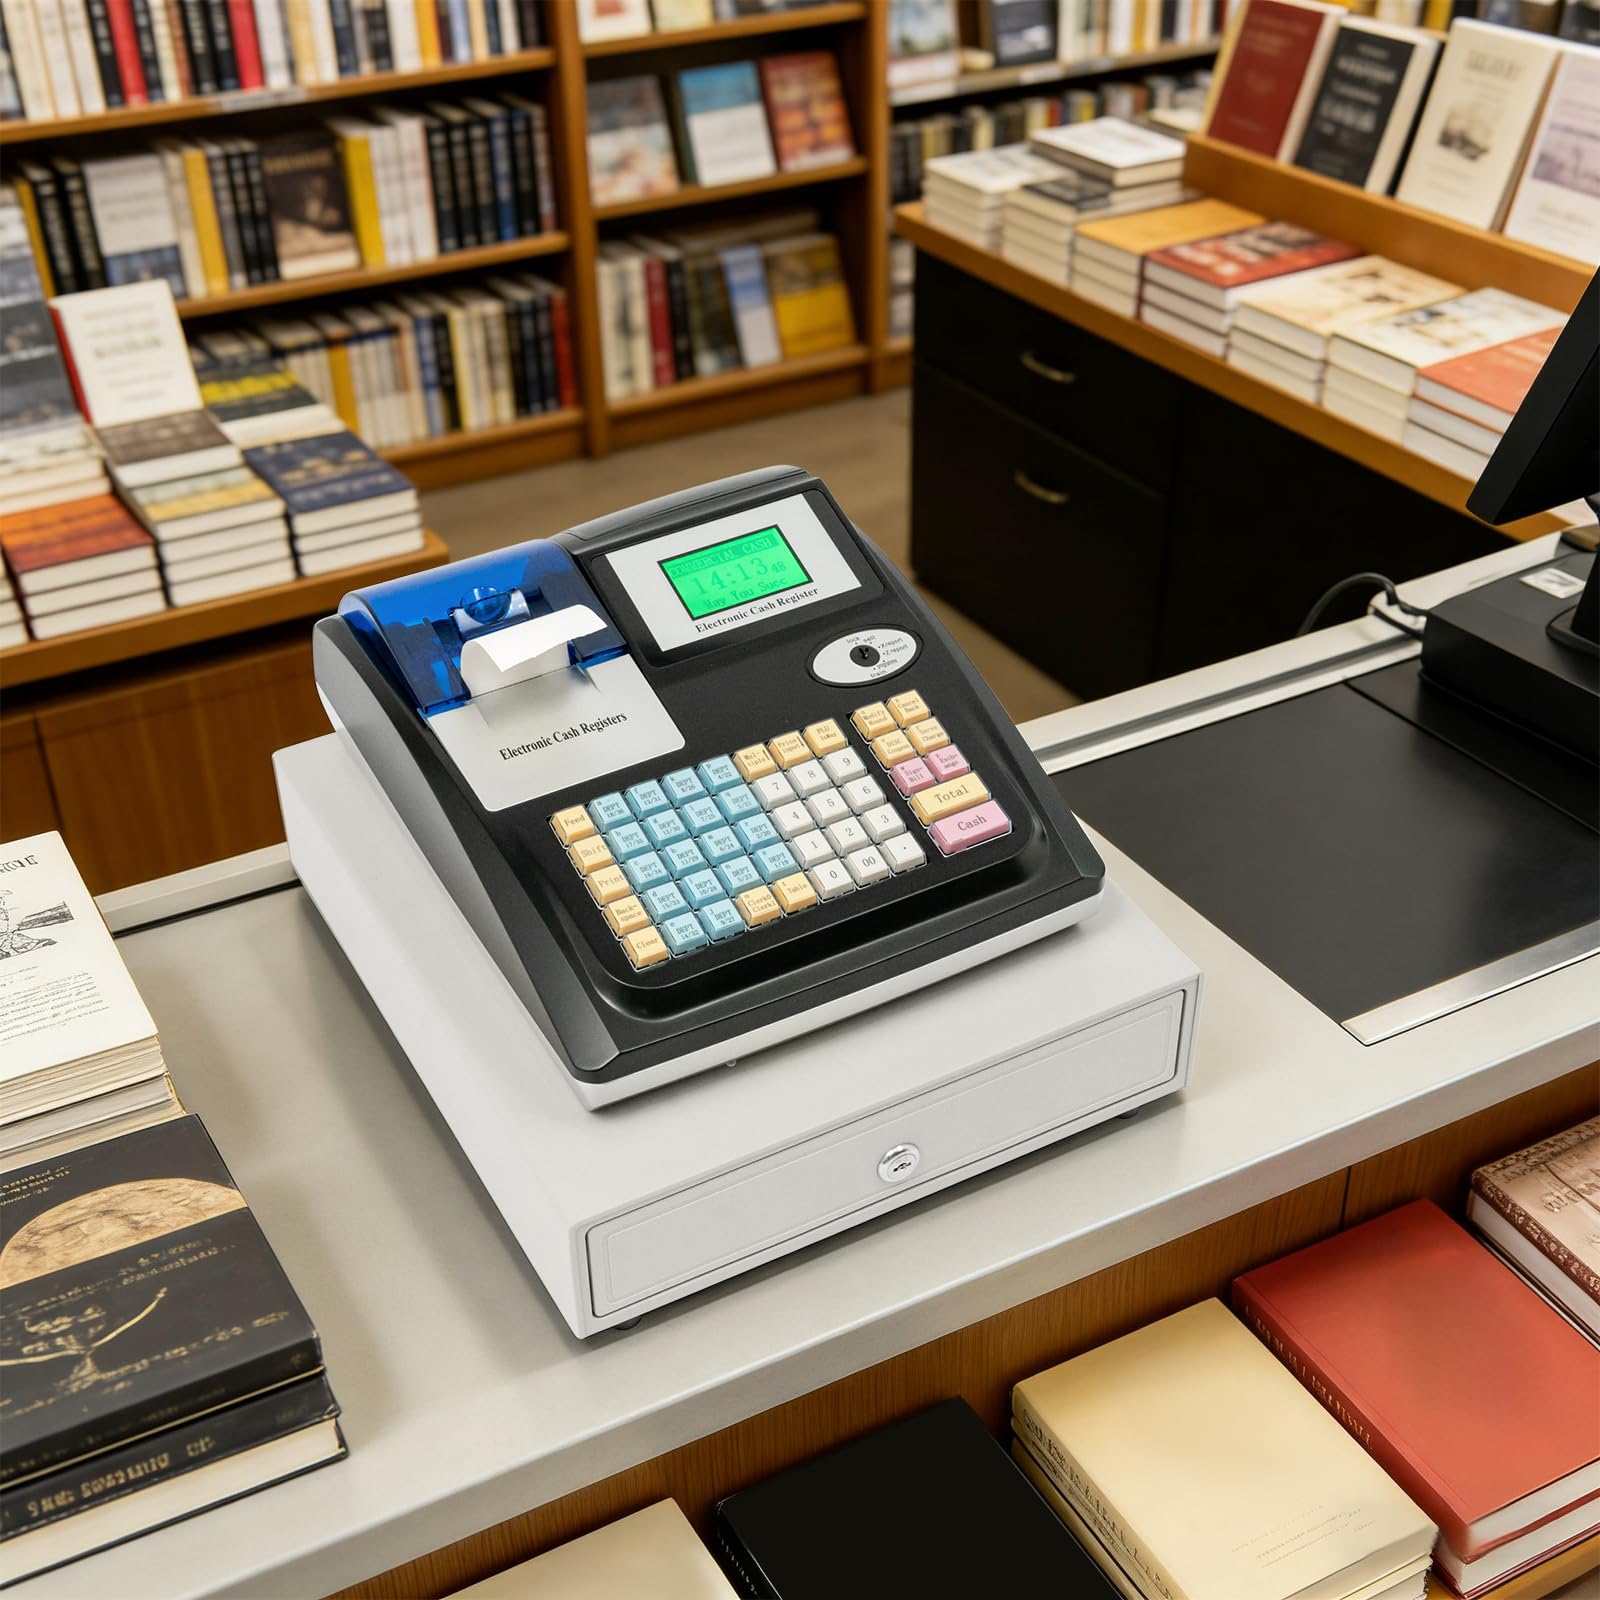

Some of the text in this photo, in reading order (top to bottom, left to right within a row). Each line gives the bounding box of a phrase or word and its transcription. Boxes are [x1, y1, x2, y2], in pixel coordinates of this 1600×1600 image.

[742, 537, 772, 553] CASH
[692, 558, 769, 596] 14:13
[730, 587, 754, 602] You
[695, 587, 819, 633] Electronic Cash Register
[499, 712, 628, 761] Electronic Cash Registers
[843, 757, 851, 766] 9
[711, 765, 729, 776] DEPT
[808, 770, 816, 778] 8
[676, 777, 693, 788] DEPT
[772, 782, 779, 791] 7
[640, 790, 657, 800] DEPT
[862, 786, 871, 794] 6
[934, 785, 969, 803] Total
[732, 794, 750, 804] DEPT
[827, 799, 835, 807] 5
[603, 802, 620, 812] DEPT
[695, 806, 713, 817] DEPT
[563, 814, 586, 826] Feed
[792, 811, 800, 821] 4
[881, 815, 889, 823] 3
[660, 819, 676, 829] DEPT
[750, 823, 768, 834] DEPT
[957, 815, 987, 831] Cash
[622, 832, 639, 842] DEPT
[845, 828, 854, 837] 2
[714, 835, 731, 846] DEPT
[811, 841, 819, 849] 1
[580, 845, 607, 858] Shift
[676, 849, 696, 860] DEPT
[768, 852, 786, 863] DEPT
[862, 856, 876, 868] 00
[640, 862, 658, 873] DEPT
[731, 866, 751, 877] DEPT
[829, 871, 838, 879] 0
[598, 874, 623, 888] Print
[695, 880, 713, 890] DEPT
[657, 892, 676, 903] DEPT
[714, 910, 732, 920] DEPT
[675, 923, 694, 934] DEPT
[636, 937, 658, 949] Clear
